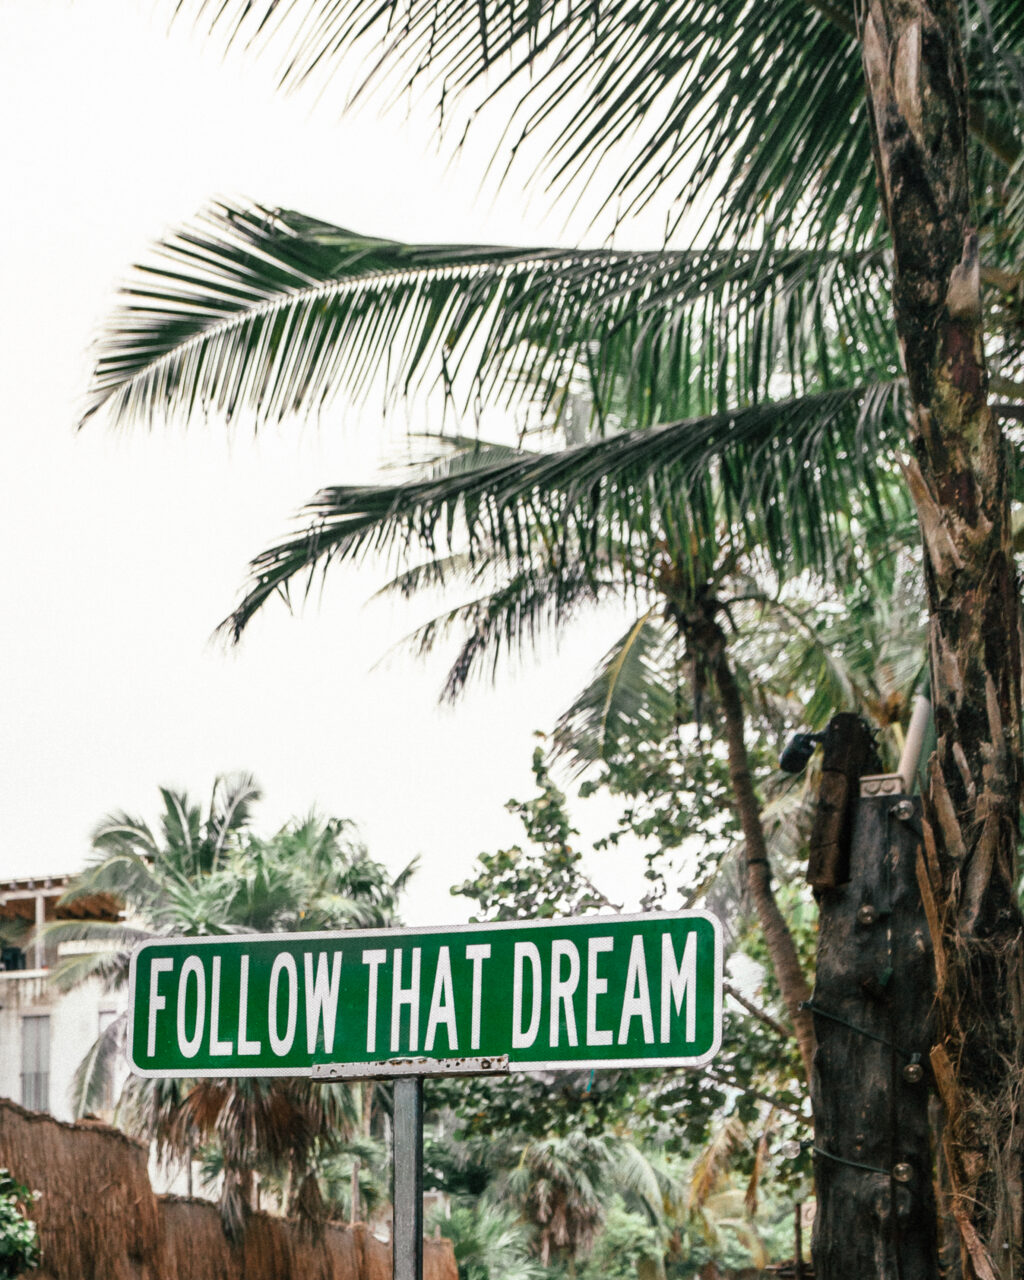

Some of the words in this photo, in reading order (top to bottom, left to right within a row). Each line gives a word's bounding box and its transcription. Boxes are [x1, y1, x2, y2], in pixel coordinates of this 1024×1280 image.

[147, 950, 343, 1059] FOLLOW
[362, 943, 491, 1053] THAT
[511, 930, 698, 1049] DREAM
